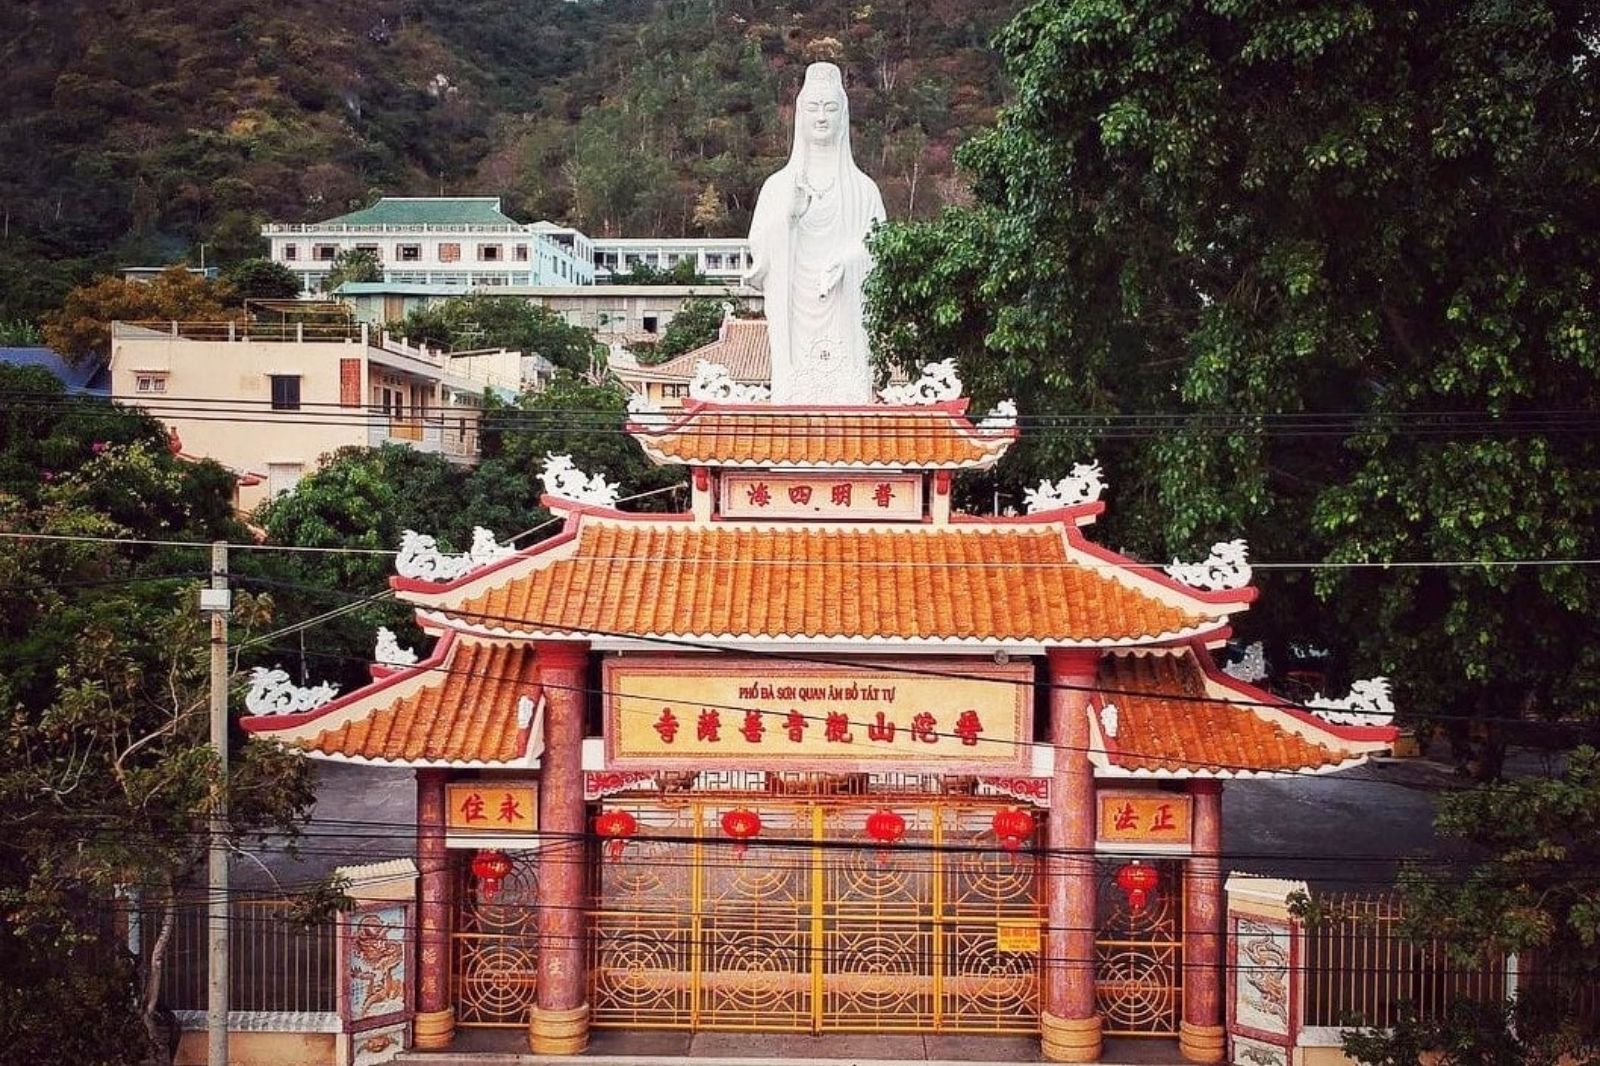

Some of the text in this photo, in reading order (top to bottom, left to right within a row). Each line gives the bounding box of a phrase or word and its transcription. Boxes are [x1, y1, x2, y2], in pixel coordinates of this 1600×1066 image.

[777, 686, 796, 699] SƠN
[799, 687, 826, 702] QUAN
[828, 684, 843, 700] ÂM
[860, 684, 880, 700] TÁT
